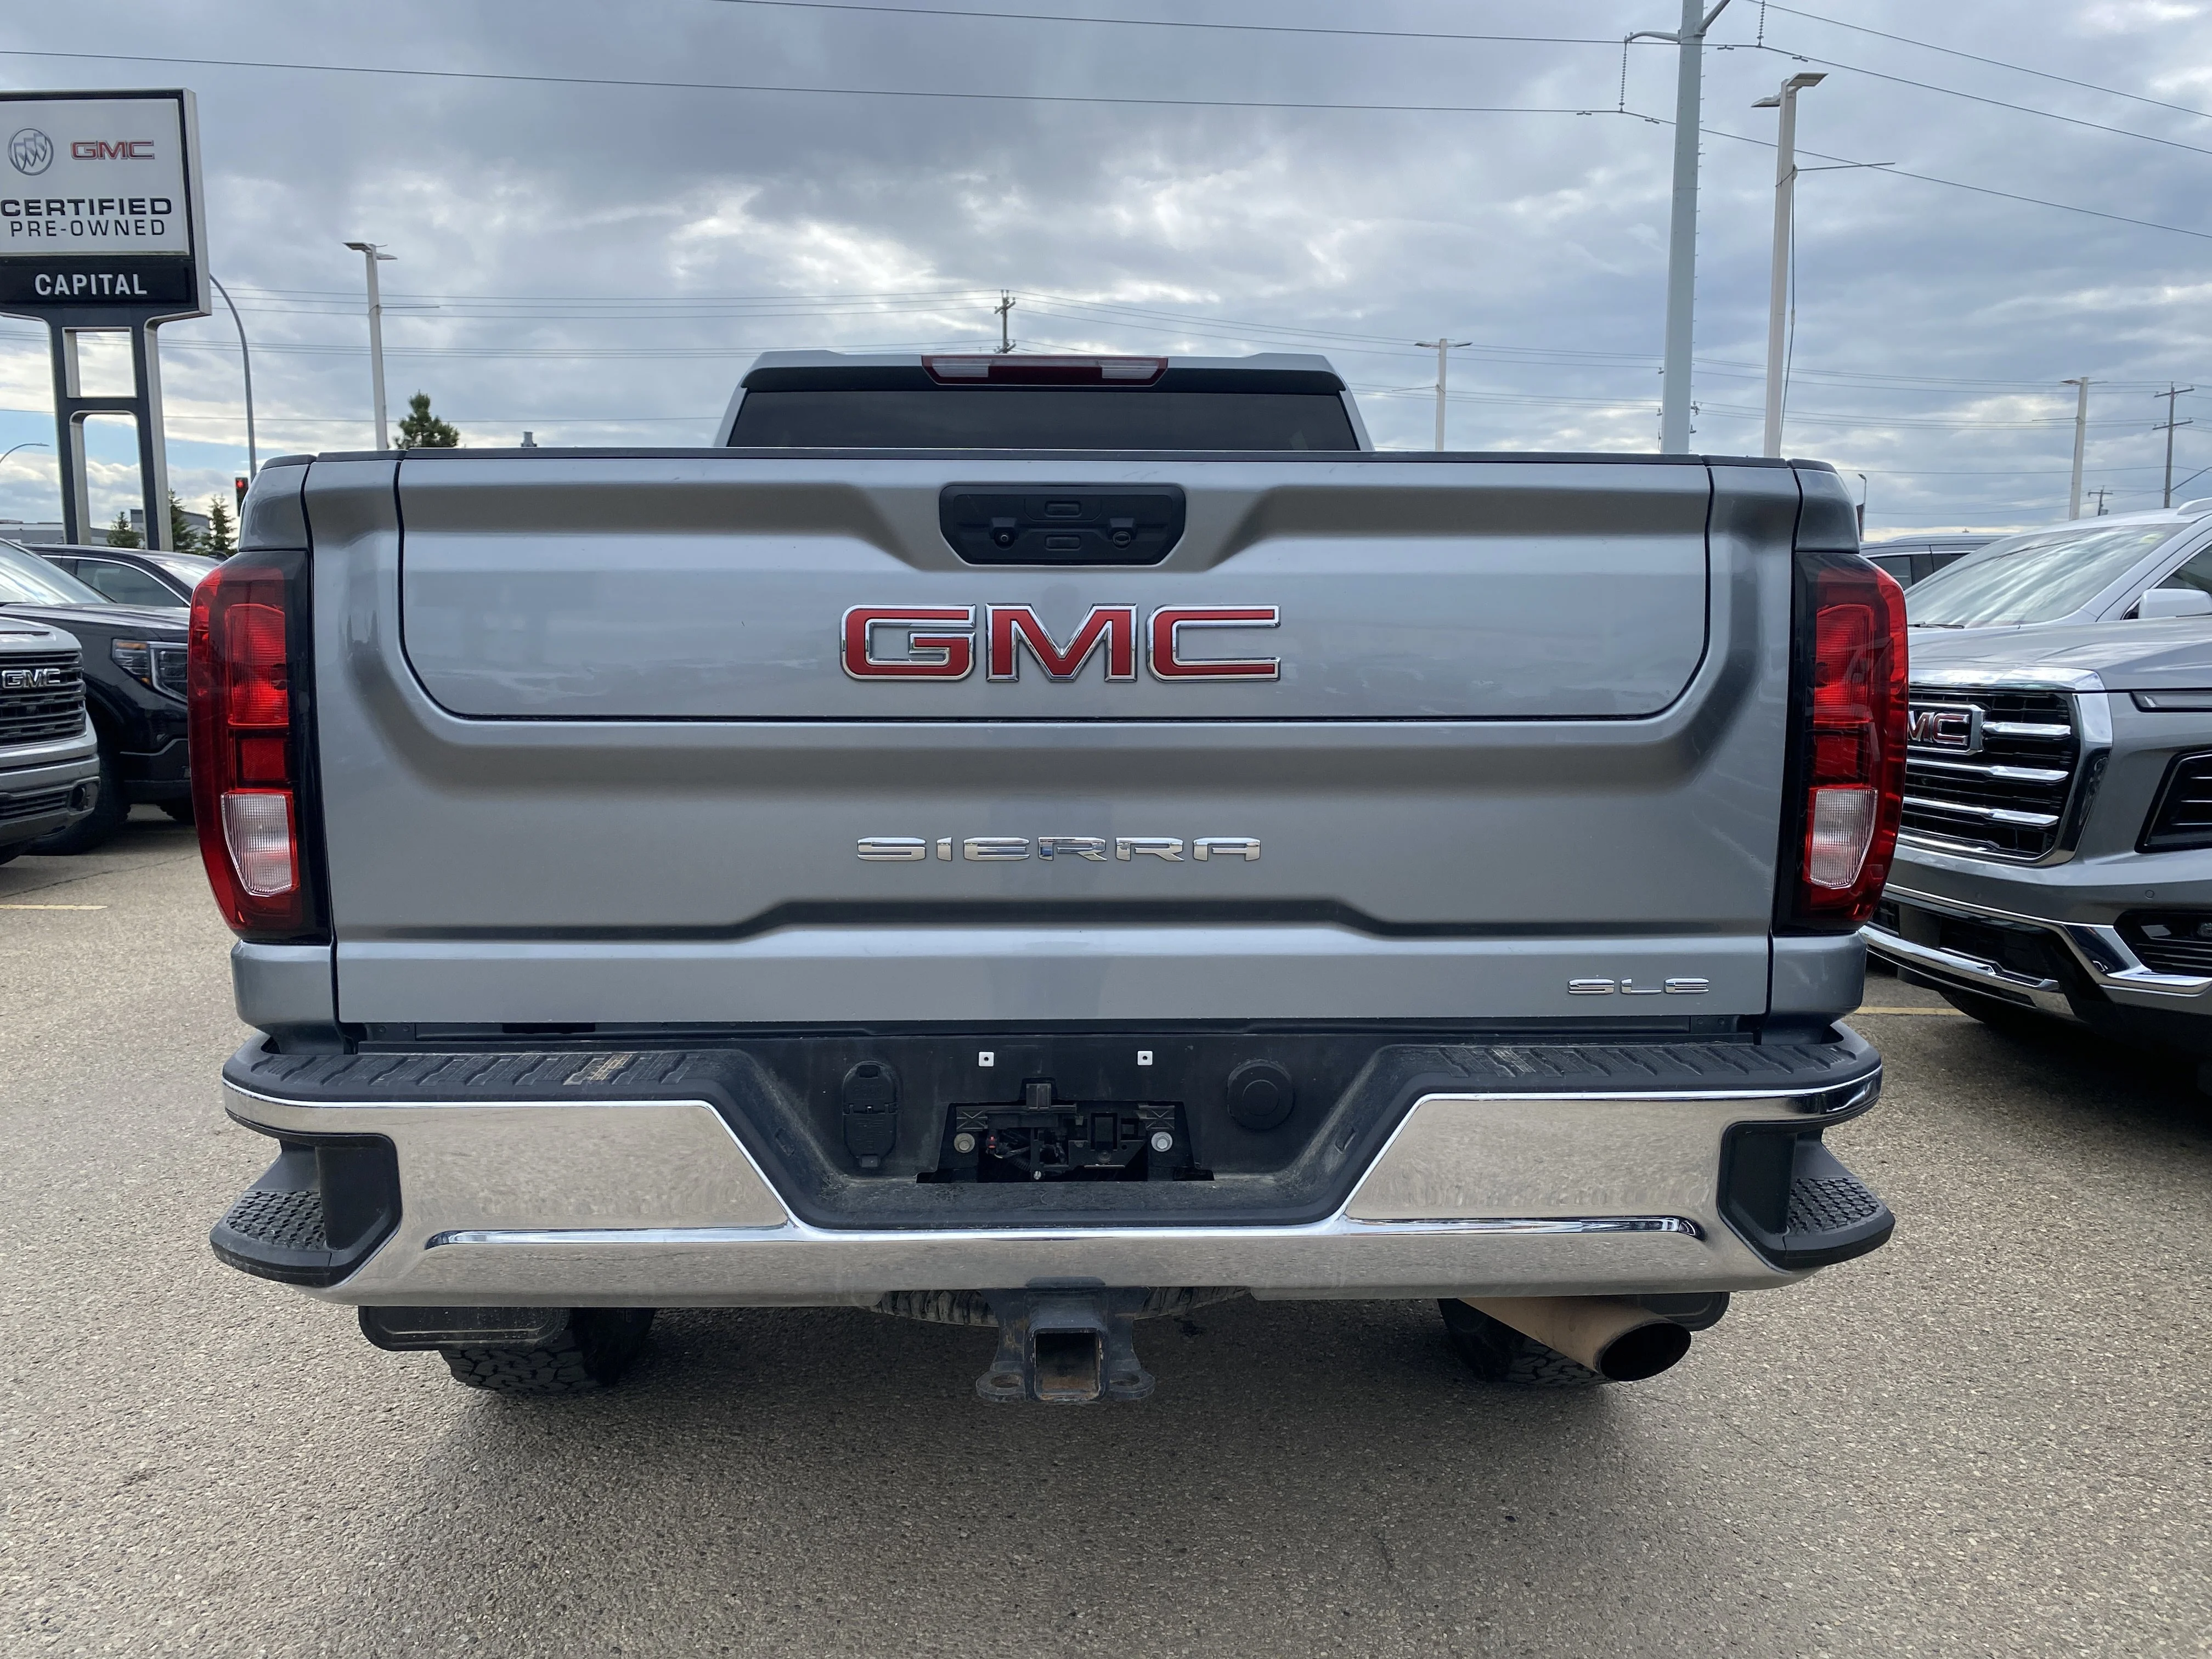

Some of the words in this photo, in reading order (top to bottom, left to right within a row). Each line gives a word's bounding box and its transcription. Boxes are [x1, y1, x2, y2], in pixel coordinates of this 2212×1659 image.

[71, 140, 155, 160] GMC
[1, 198, 172, 216] CERTIFIED
[10, 219, 165, 236] PRE-OWNED
[35, 274, 148, 295] CAPITAL
[840, 603, 1281, 682] GMC
[2, 668, 60, 689] GMC
[1908, 710, 1970, 746] MC
[857, 836, 1261, 862] SIERRA
[1568, 978, 1709, 995] SLE
